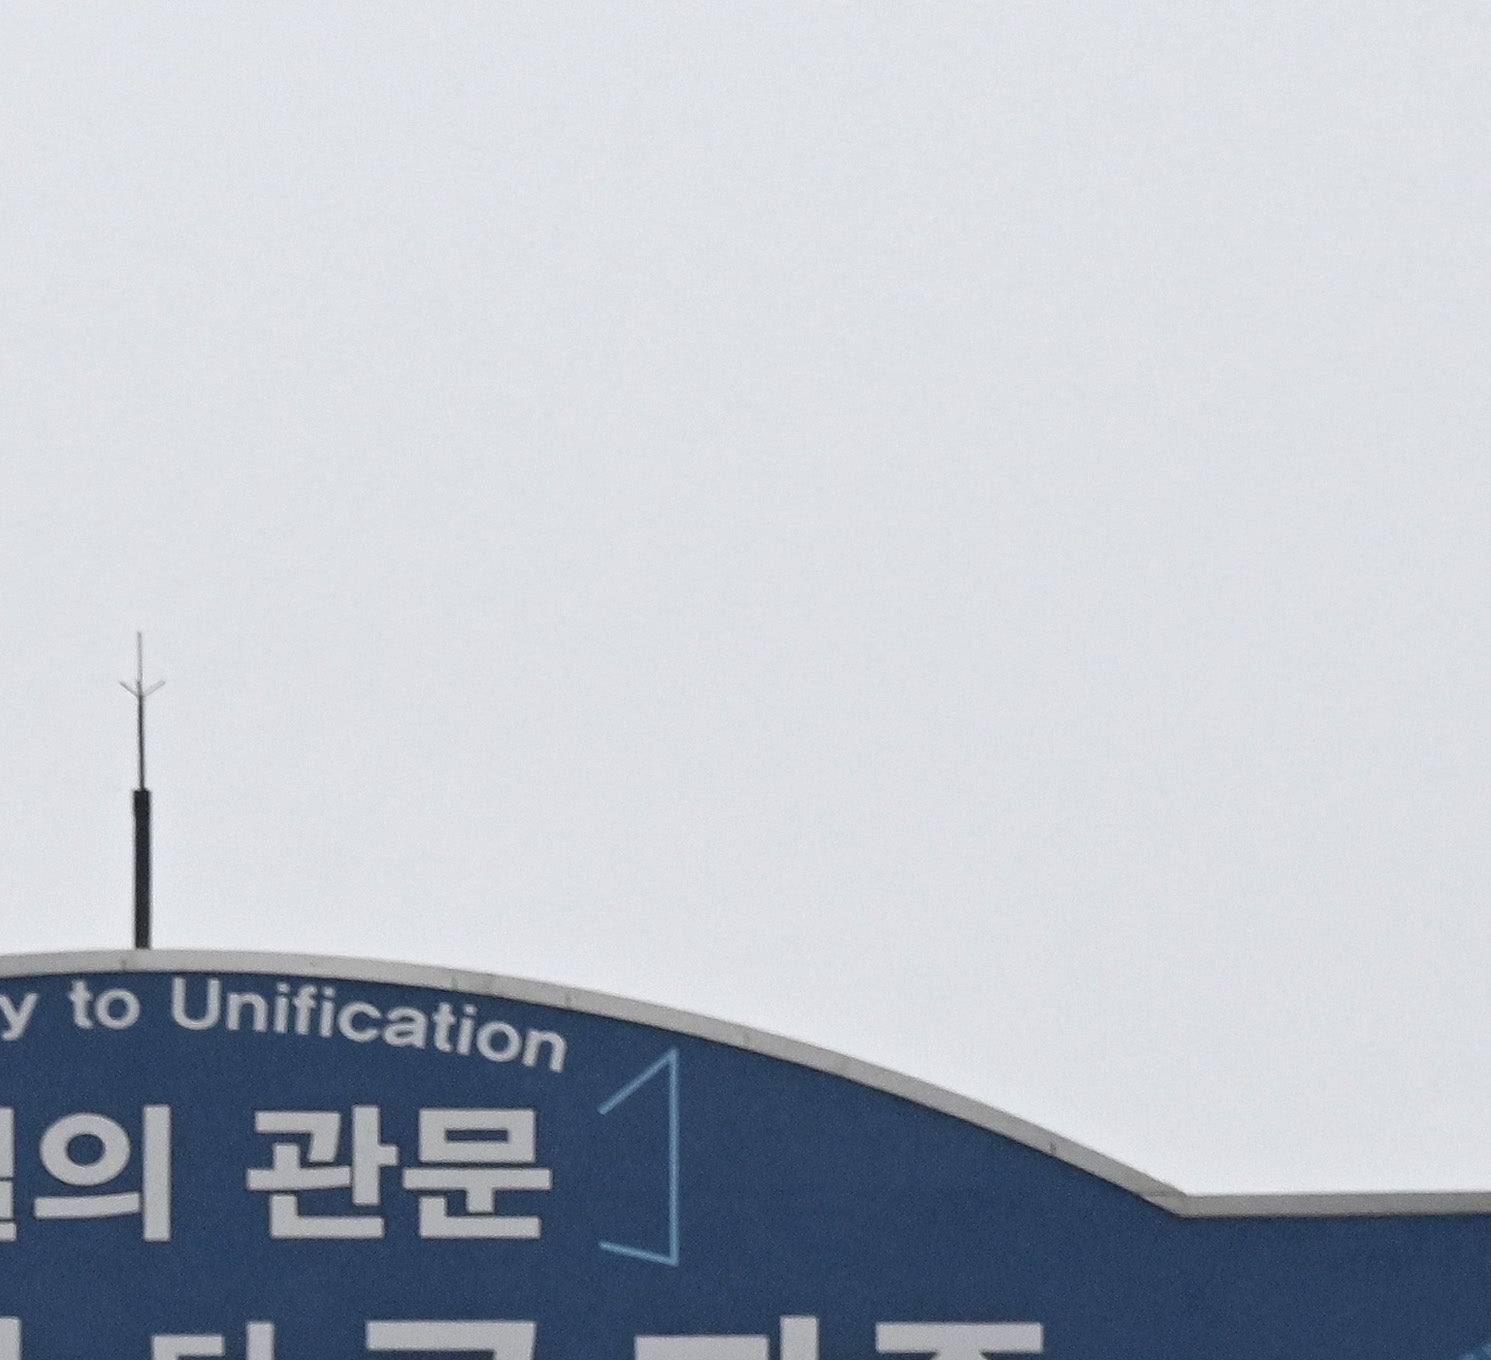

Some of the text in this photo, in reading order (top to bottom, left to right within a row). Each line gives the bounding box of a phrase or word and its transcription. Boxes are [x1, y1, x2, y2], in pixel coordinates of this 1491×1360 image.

[68, 979, 141, 1030] to
[171, 976, 568, 1073] Unification
[246, 1105, 552, 1239] 관문
